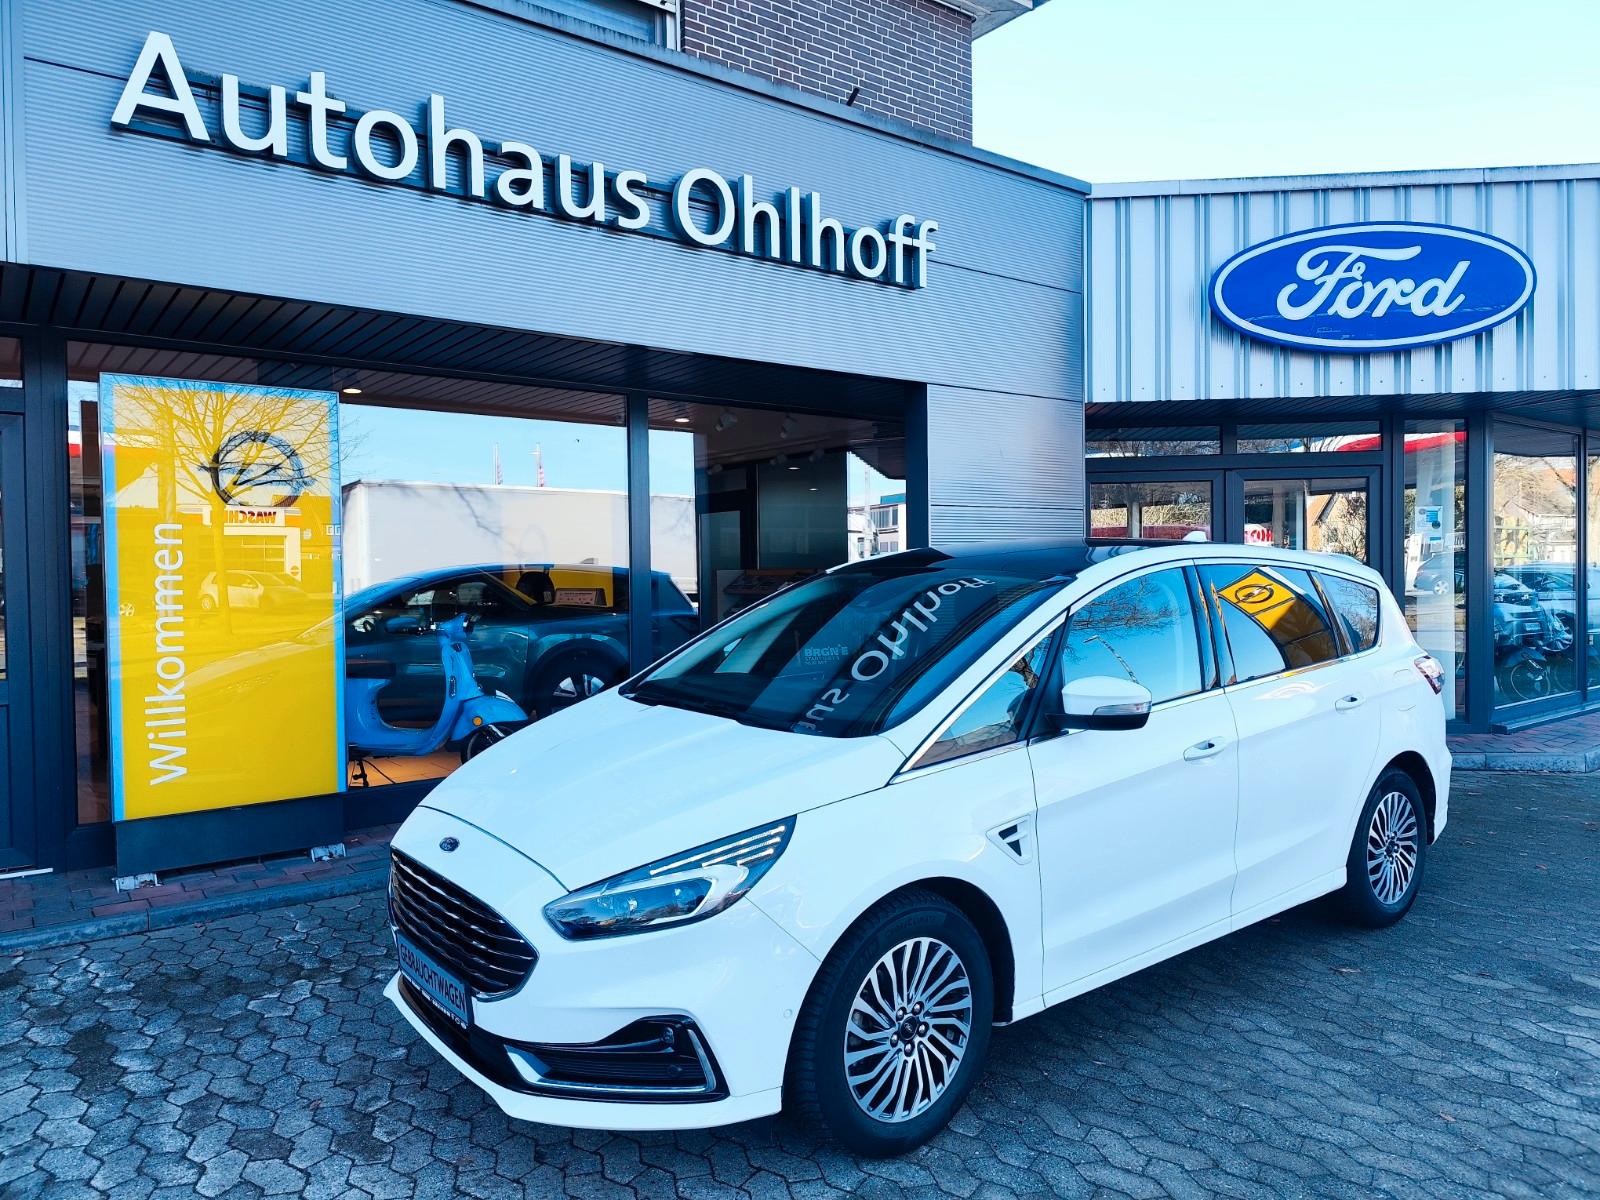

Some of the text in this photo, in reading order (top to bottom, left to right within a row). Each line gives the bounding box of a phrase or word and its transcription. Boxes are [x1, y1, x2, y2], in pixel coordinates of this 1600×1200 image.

[110, 31, 939, 288] Autohaus Ohlhoff
[1276, 245, 1471, 321] Ford
[144, 523, 188, 786] Willkommen
[400, 943, 468, 1015] GEBRAUCHTWAGEN
